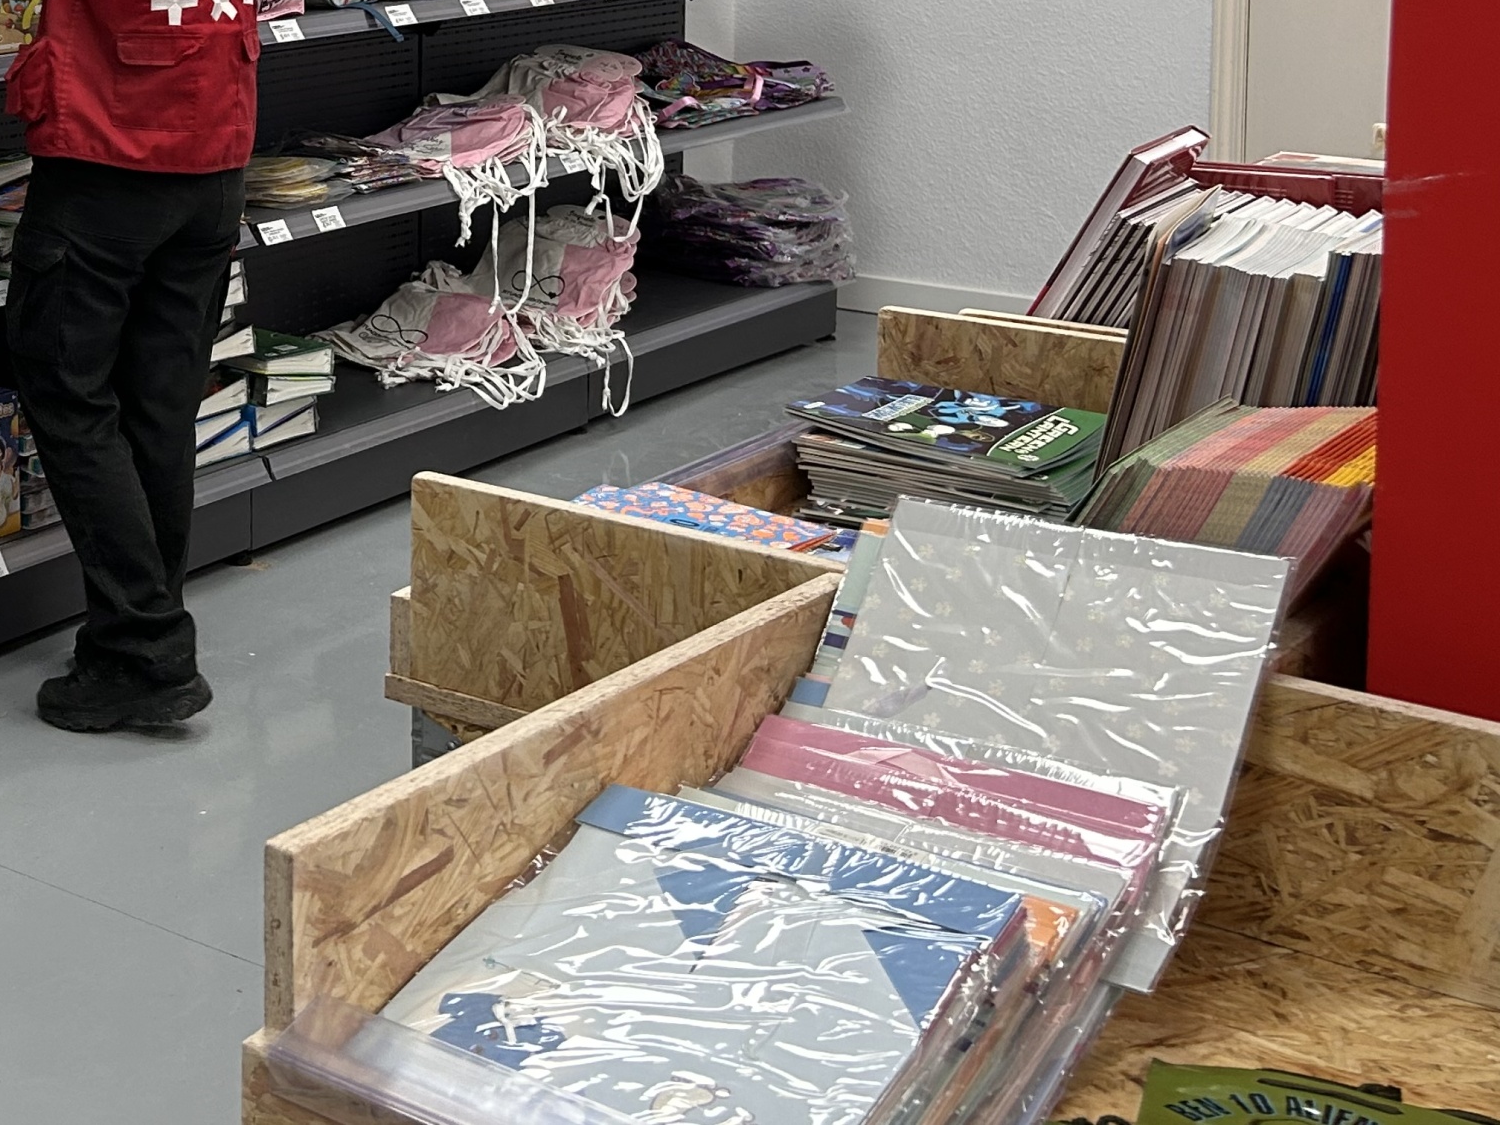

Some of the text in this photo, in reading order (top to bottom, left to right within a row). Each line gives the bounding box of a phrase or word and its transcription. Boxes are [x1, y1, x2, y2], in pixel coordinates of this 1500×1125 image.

[999, 414, 1071, 452] LANTERN
[1015, 422, 1079, 455] GREEN
[1165, 1094, 1231, 1123] BEN
[1230, 1092, 1274, 1115] 10
